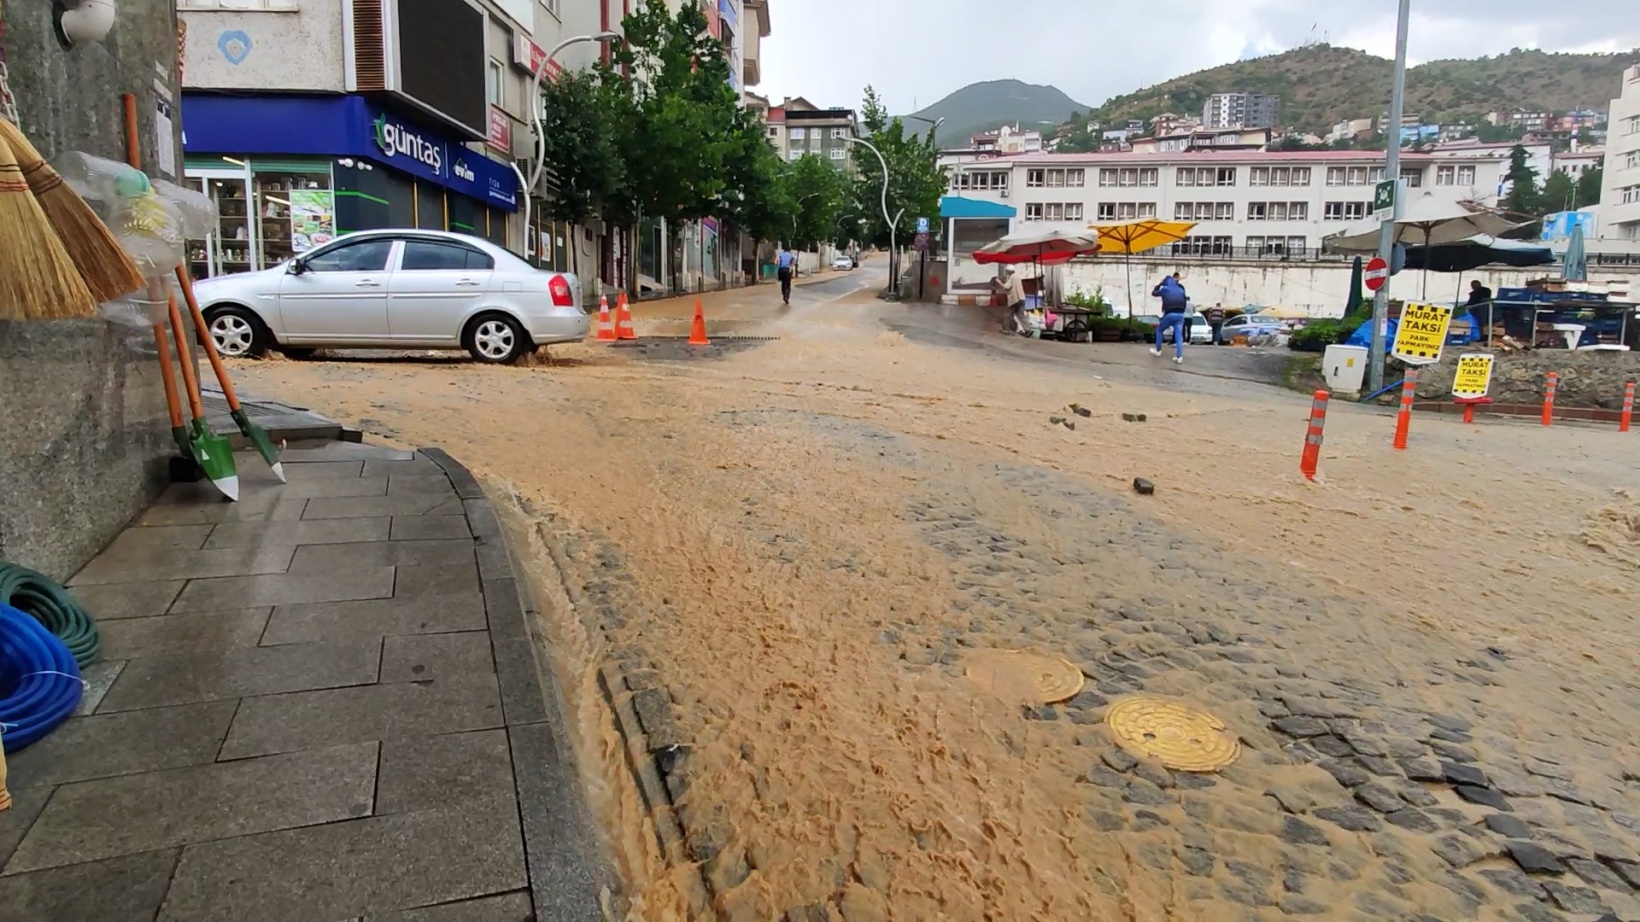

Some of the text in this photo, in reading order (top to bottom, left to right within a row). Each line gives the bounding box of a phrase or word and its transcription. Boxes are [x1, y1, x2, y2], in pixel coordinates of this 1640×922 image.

[383, 123, 442, 176] güntaş
[454, 164, 475, 182] evim
[1405, 310, 1446, 321] MURAT
[1409, 334, 1430, 342] PARK
